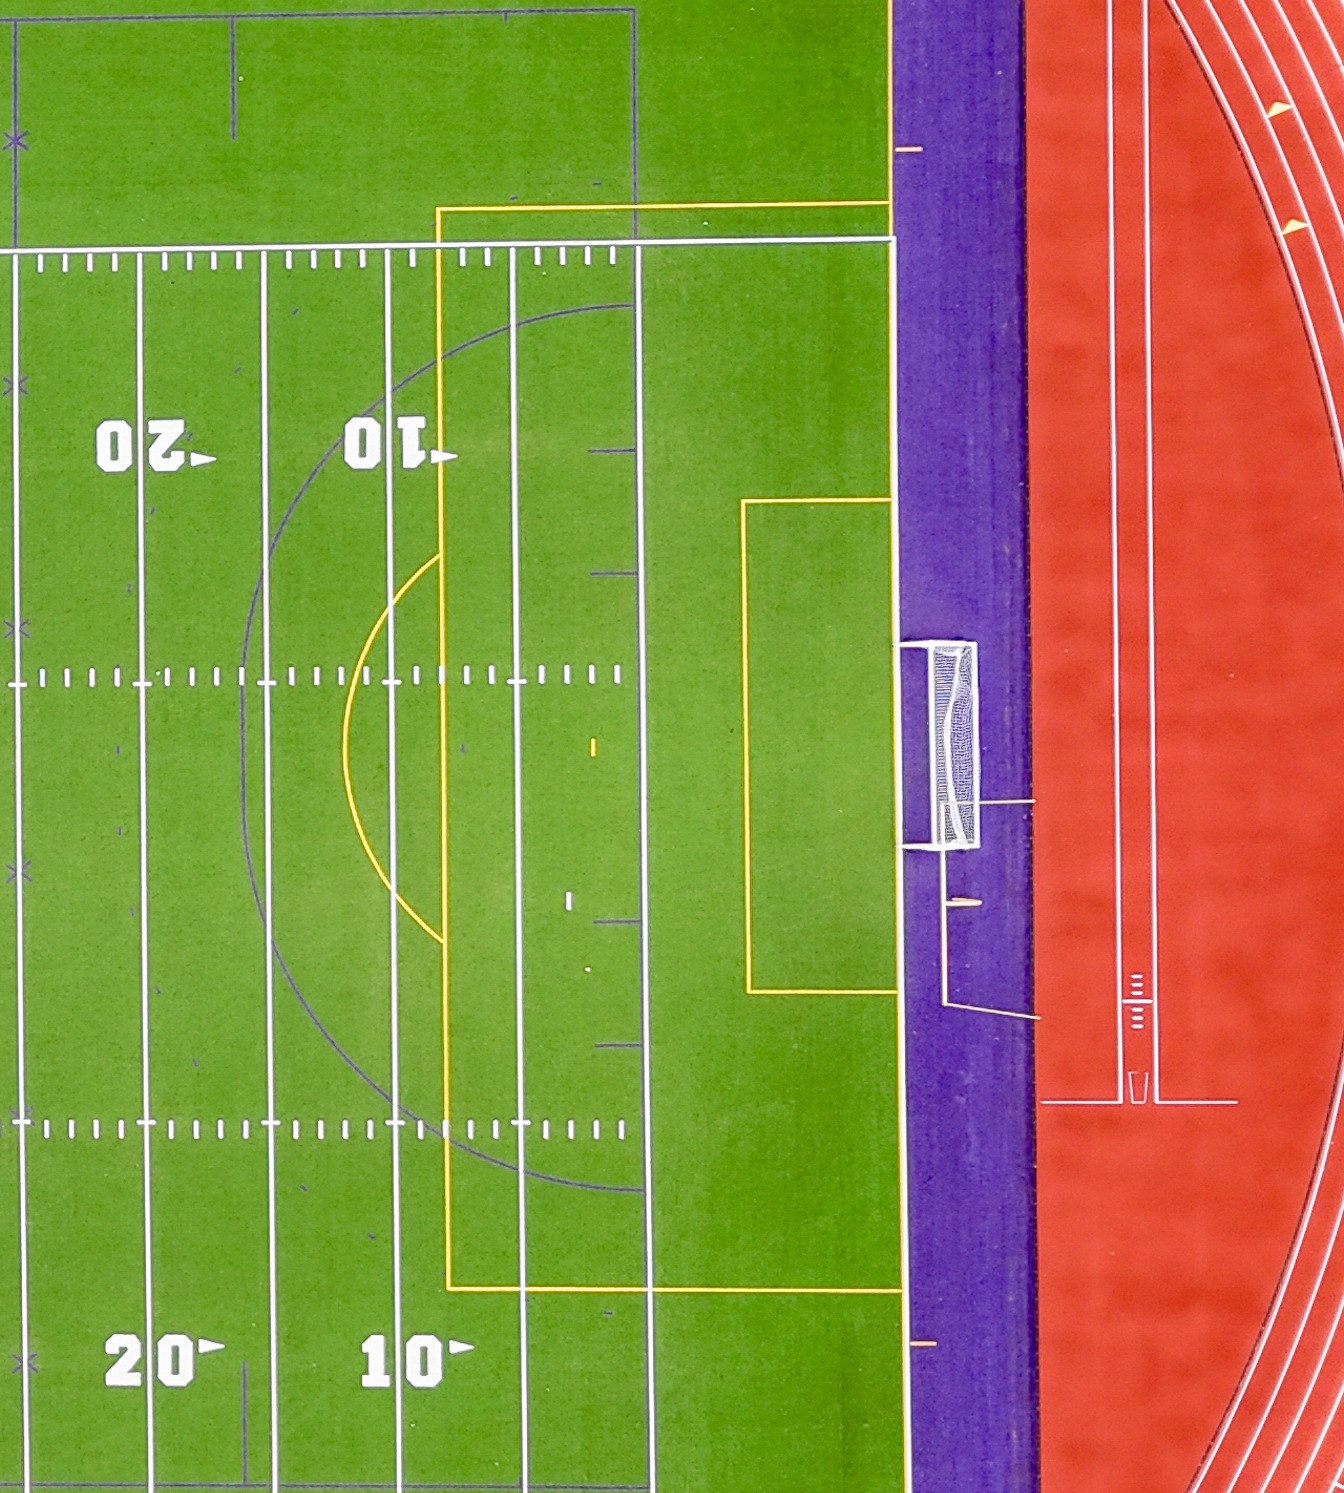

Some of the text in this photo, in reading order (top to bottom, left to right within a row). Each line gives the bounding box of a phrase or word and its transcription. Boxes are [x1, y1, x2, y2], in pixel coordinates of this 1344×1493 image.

[96, 419, 186, 472] 20
[343, 416, 427, 469] 10
[104, 1333, 194, 1387] 20
[361, 1334, 444, 1388] 10
